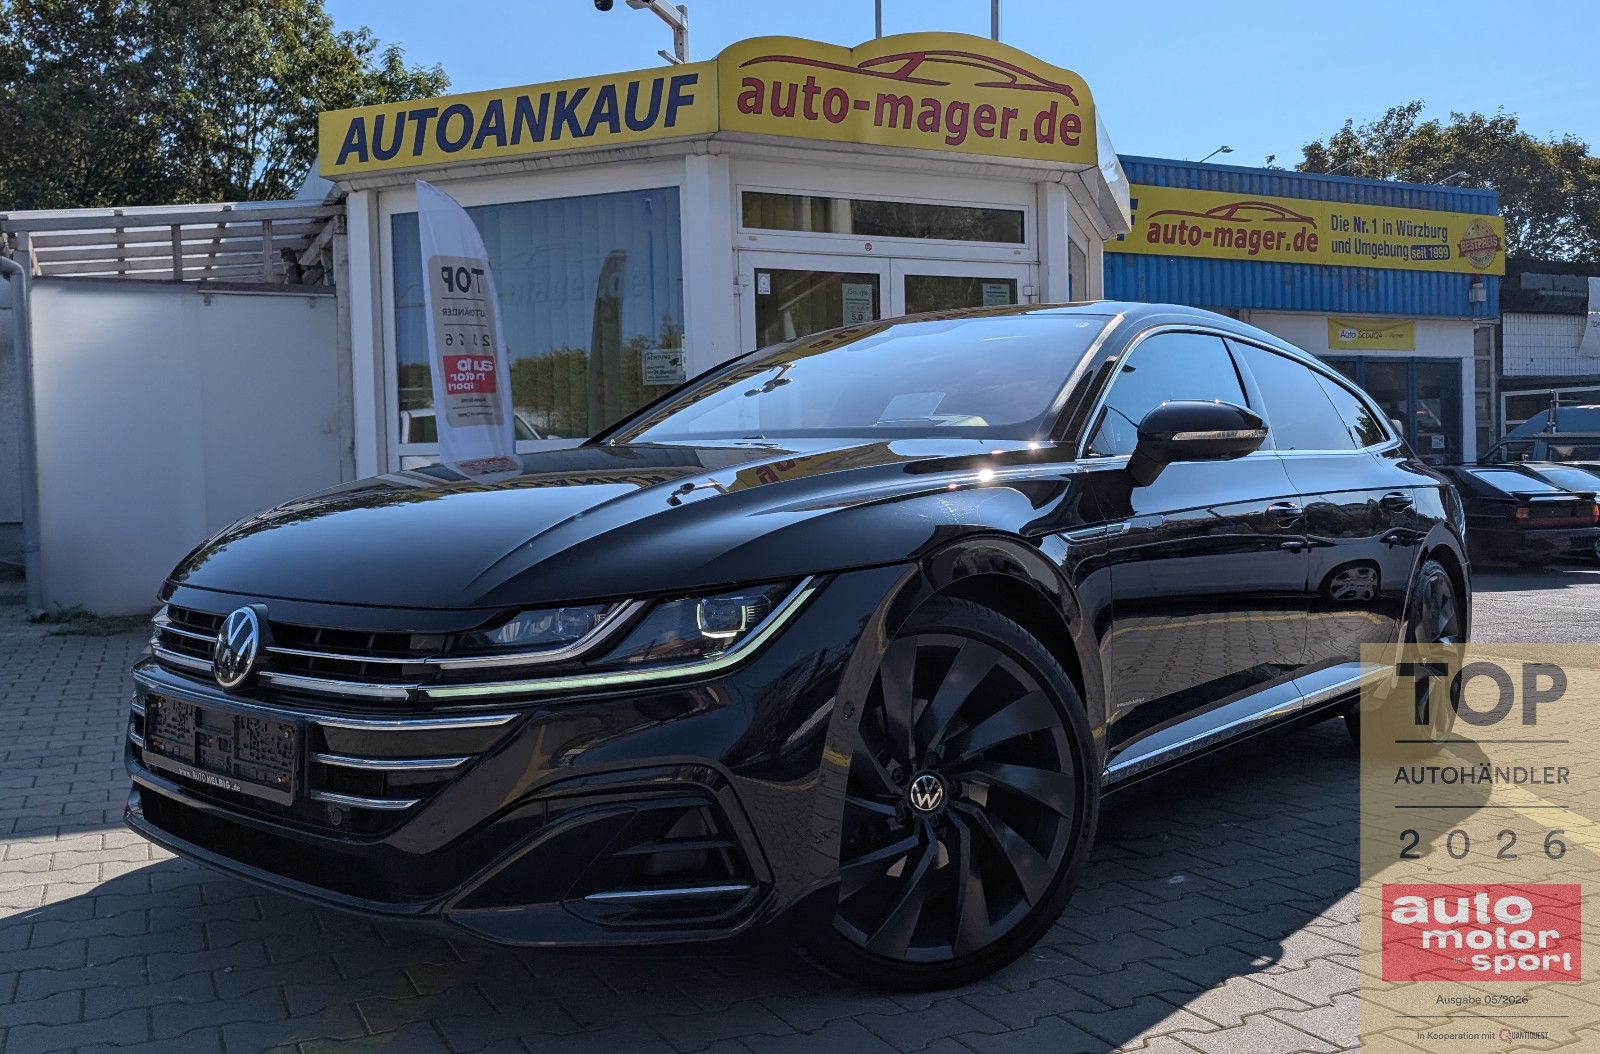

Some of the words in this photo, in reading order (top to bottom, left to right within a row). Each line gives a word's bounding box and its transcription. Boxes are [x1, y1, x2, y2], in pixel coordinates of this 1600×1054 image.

[335, 73, 699, 165] AUTOANKAUF
[737, 76, 1082, 146] auto-mager.de
[1147, 220, 1319, 256] auto-mager.de
[1331, 214, 1350, 232] Die
[1353, 216, 1369, 234] Nr.
[1371, 219, 1378, 235] 1
[1382, 218, 1393, 236] in
[1396, 220, 1448, 244] Würzburg
[1331, 238, 1351, 254] und
[1354, 239, 1409, 262] Umgebung
[1411, 247, 1427, 259] seit
[1429, 246, 1449, 260] 1999
